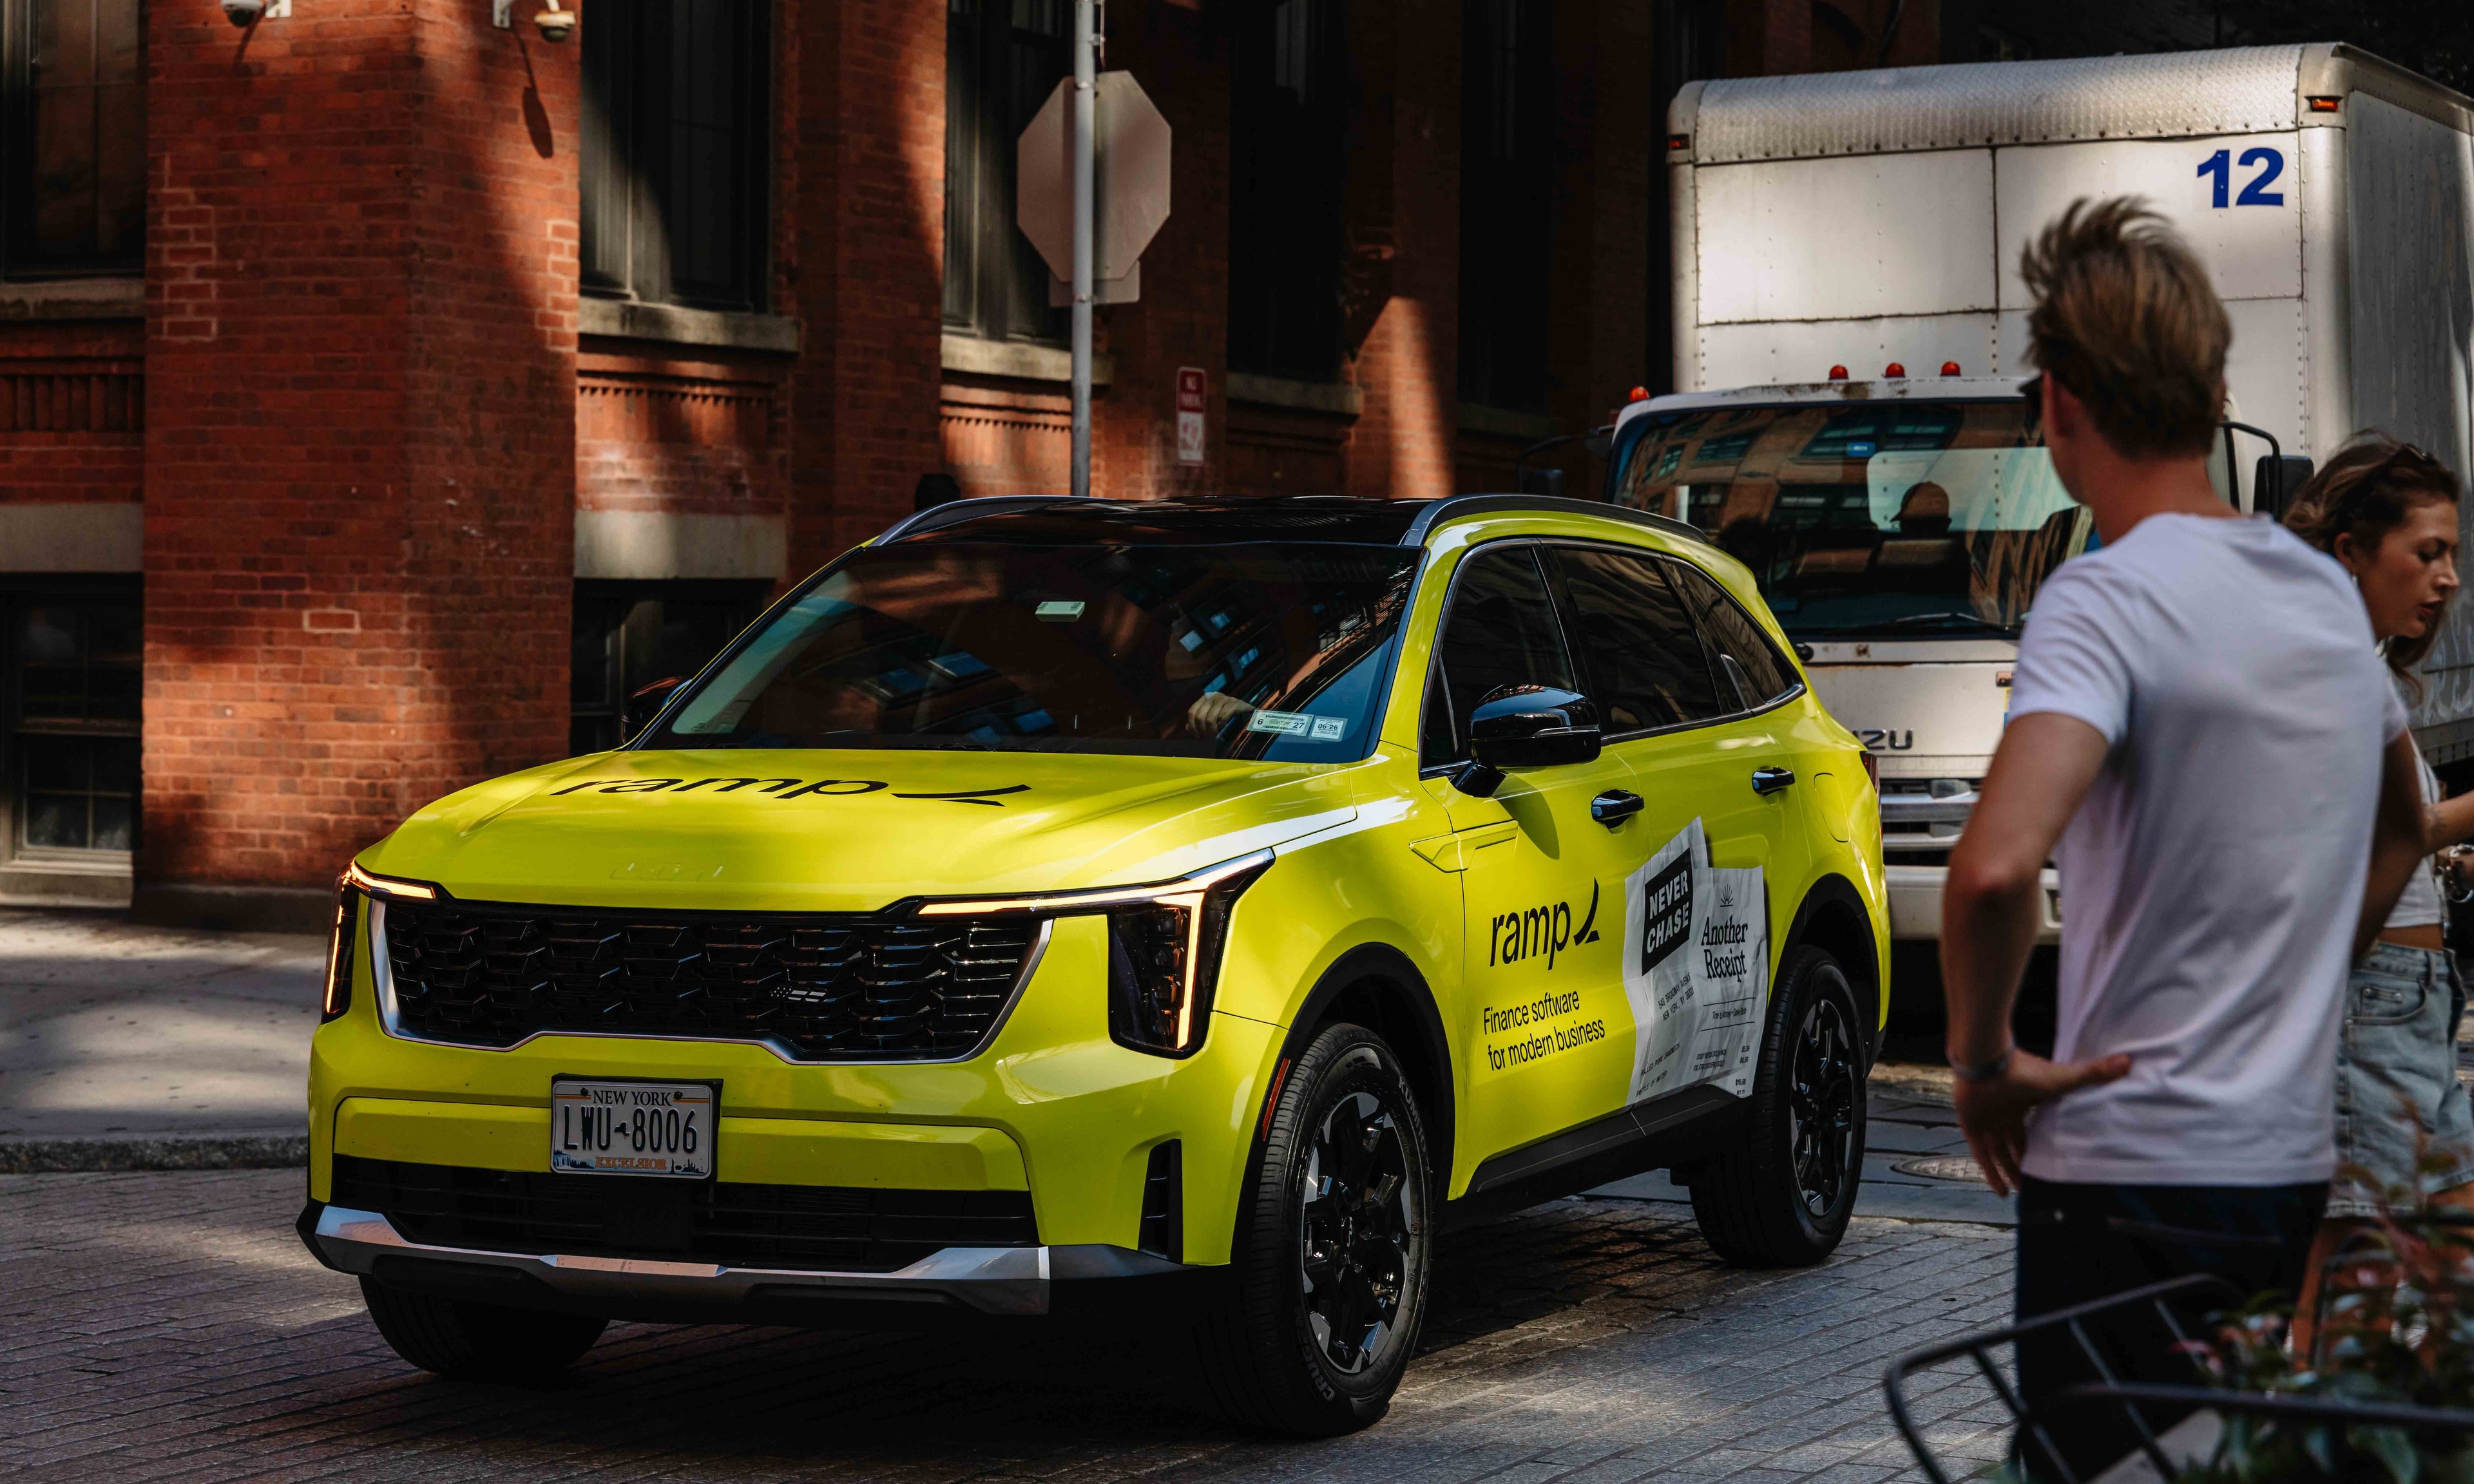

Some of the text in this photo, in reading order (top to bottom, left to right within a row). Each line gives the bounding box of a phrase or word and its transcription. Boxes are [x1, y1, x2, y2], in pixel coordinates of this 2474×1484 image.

[2196, 147, 2284, 209] 12
[548, 776, 888, 799] ramp
[1649, 870, 1688, 920] NEVER
[1490, 901, 1571, 971] ramp
[1647, 902, 1689, 953] CHASE
[1701, 913, 1749, 946] Another
[1703, 947, 1747, 983] Receipt
[1665, 982, 1680, 1003] BROADWAY
[1669, 1002, 1680, 1014] YORK,
[1680, 995, 1685, 1005] NY
[1484, 991, 1580, 1035] Finance software
[1488, 1018, 1606, 1072] for modern business
[1654, 1056, 1664, 1067] PORK
[1650, 1078, 1656, 1088] OF
[1656, 1070, 1668, 1083] WATER
[593, 1090, 672, 1107] NEW YORK
[564, 1105, 697, 1154] LWU 8006
[595, 1156, 667, 1171] EXCELSIOR
